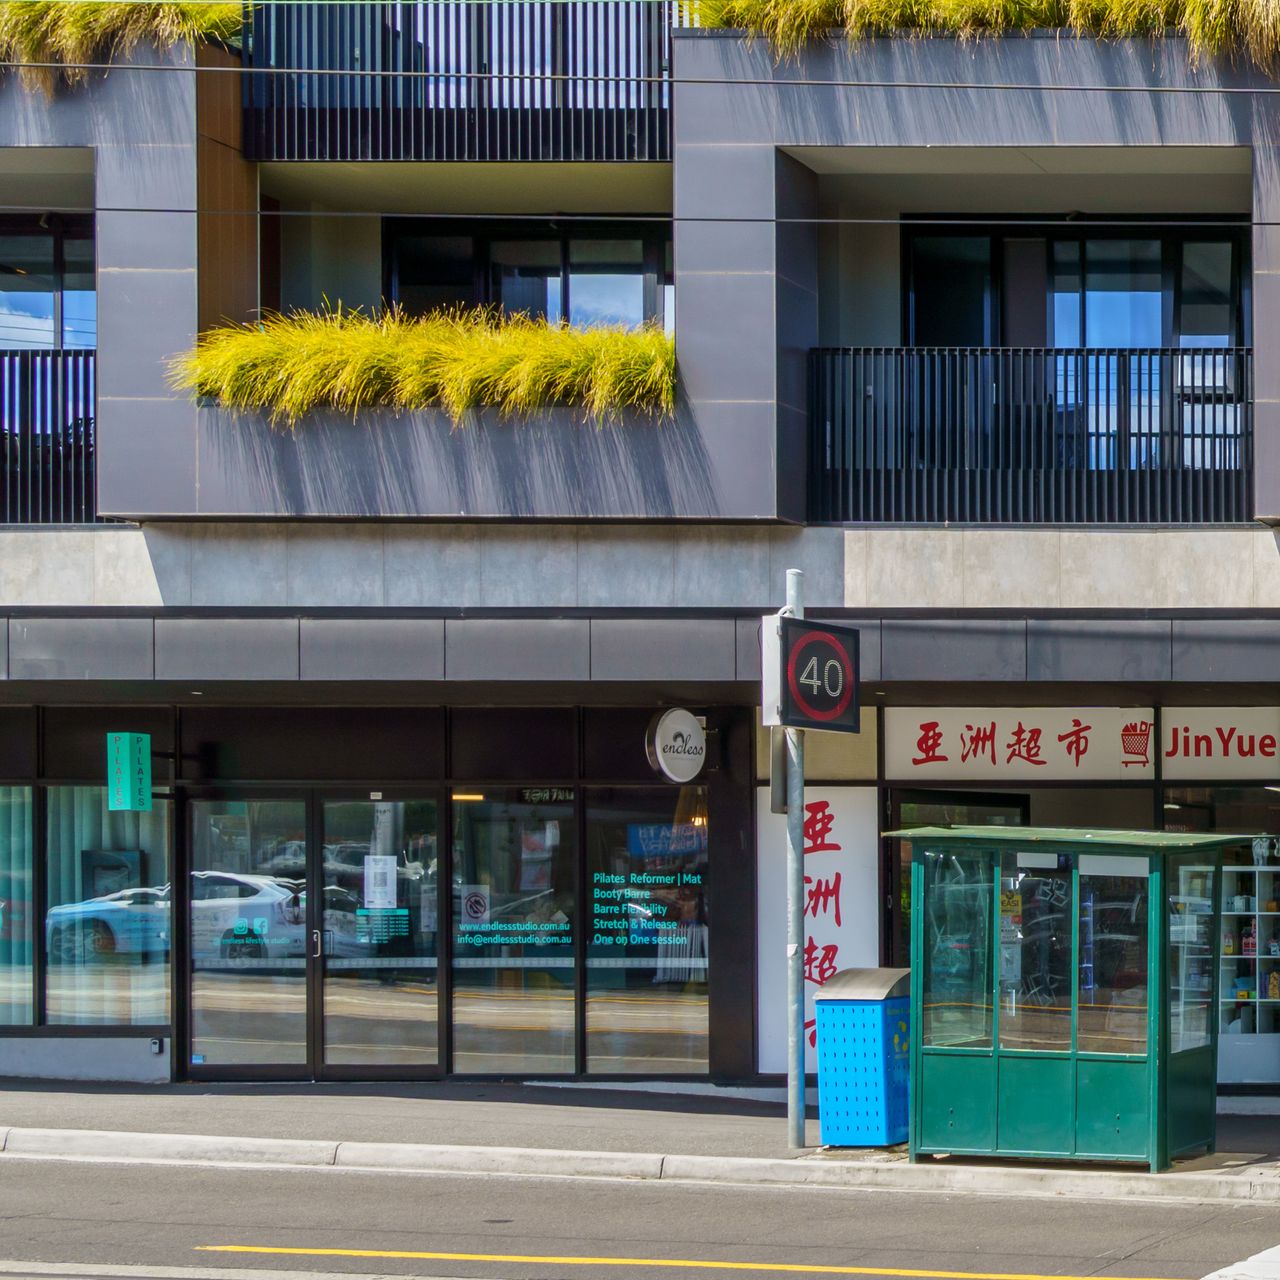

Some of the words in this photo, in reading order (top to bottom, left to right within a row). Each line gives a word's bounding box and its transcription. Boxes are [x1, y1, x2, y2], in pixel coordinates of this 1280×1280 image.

[800, 656, 843, 697] 40
[662, 732, 703, 756] endless
[1165, 726, 1277, 758] JinYue
[114, 735, 123, 807] PILATES
[136, 736, 145, 807] PILATES
[594, 872, 626, 884] Pilates
[630, 872, 675, 884] Reformer
[683, 873, 702, 884] Mat
[594, 888, 622, 901] Booty
[624, 888, 651, 899] Barre
[594, 903, 620, 914] Barre
[621, 903, 668, 917] Flexibility
[459, 921, 570, 931] www.endlessstudio.com.au
[594, 918, 628, 929] Stretch
[630, 919, 639, 929] &
[641, 918, 677, 929] Release
[457, 934, 572, 947] info@endlessstudio.com.au
[594, 933, 614, 945] One
[615, 936, 628, 945] on
[630, 933, 651, 945] One
[652, 934, 687, 945] session
